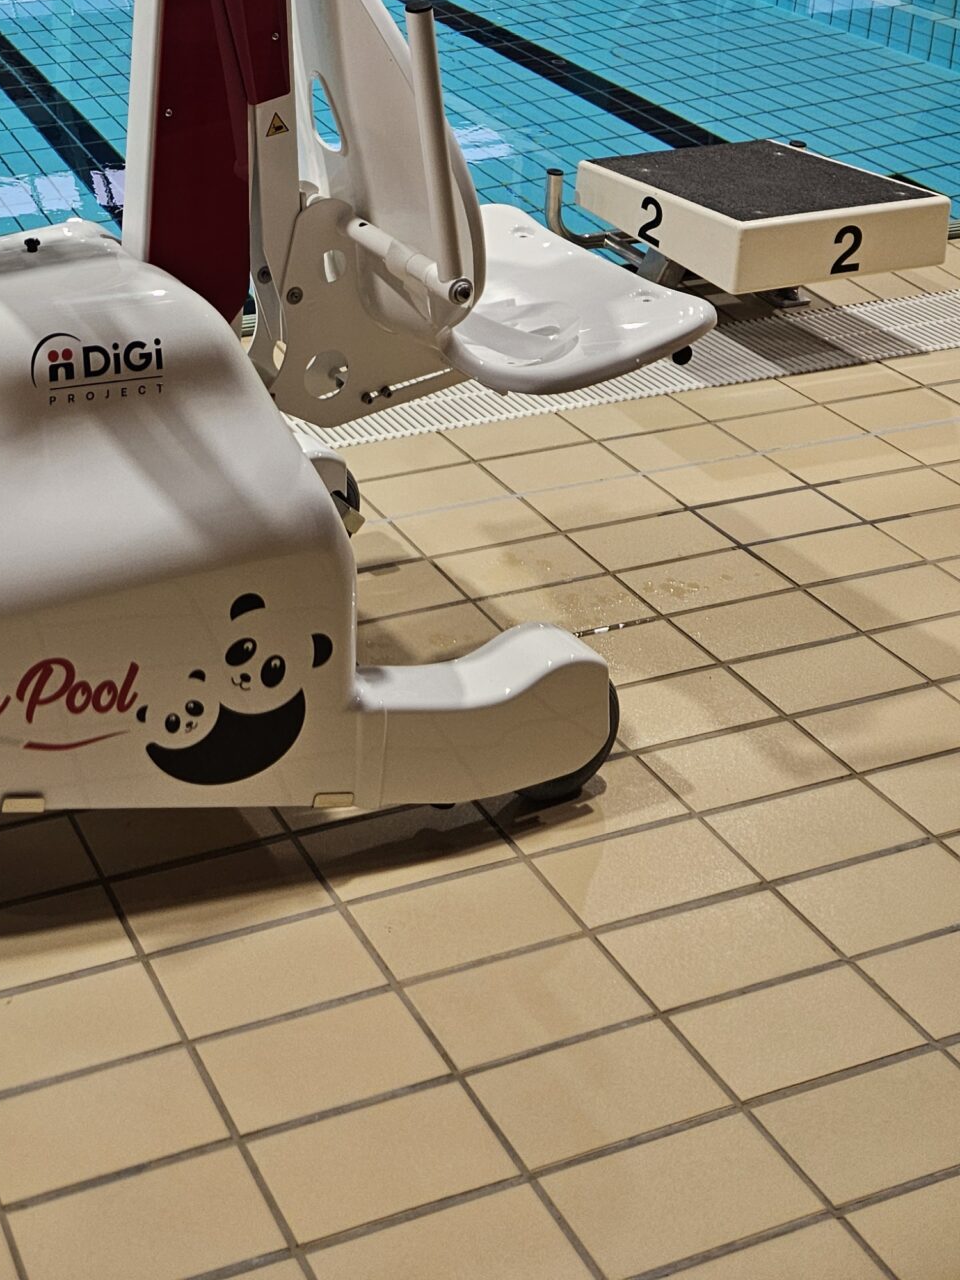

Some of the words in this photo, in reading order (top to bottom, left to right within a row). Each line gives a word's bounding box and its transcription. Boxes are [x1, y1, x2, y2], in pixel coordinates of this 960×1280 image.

[638, 196, 662, 248] 2
[830, 225, 863, 275] 2
[49, 383, 164, 405] PROJECT
[16, 657, 139, 724] Pool
